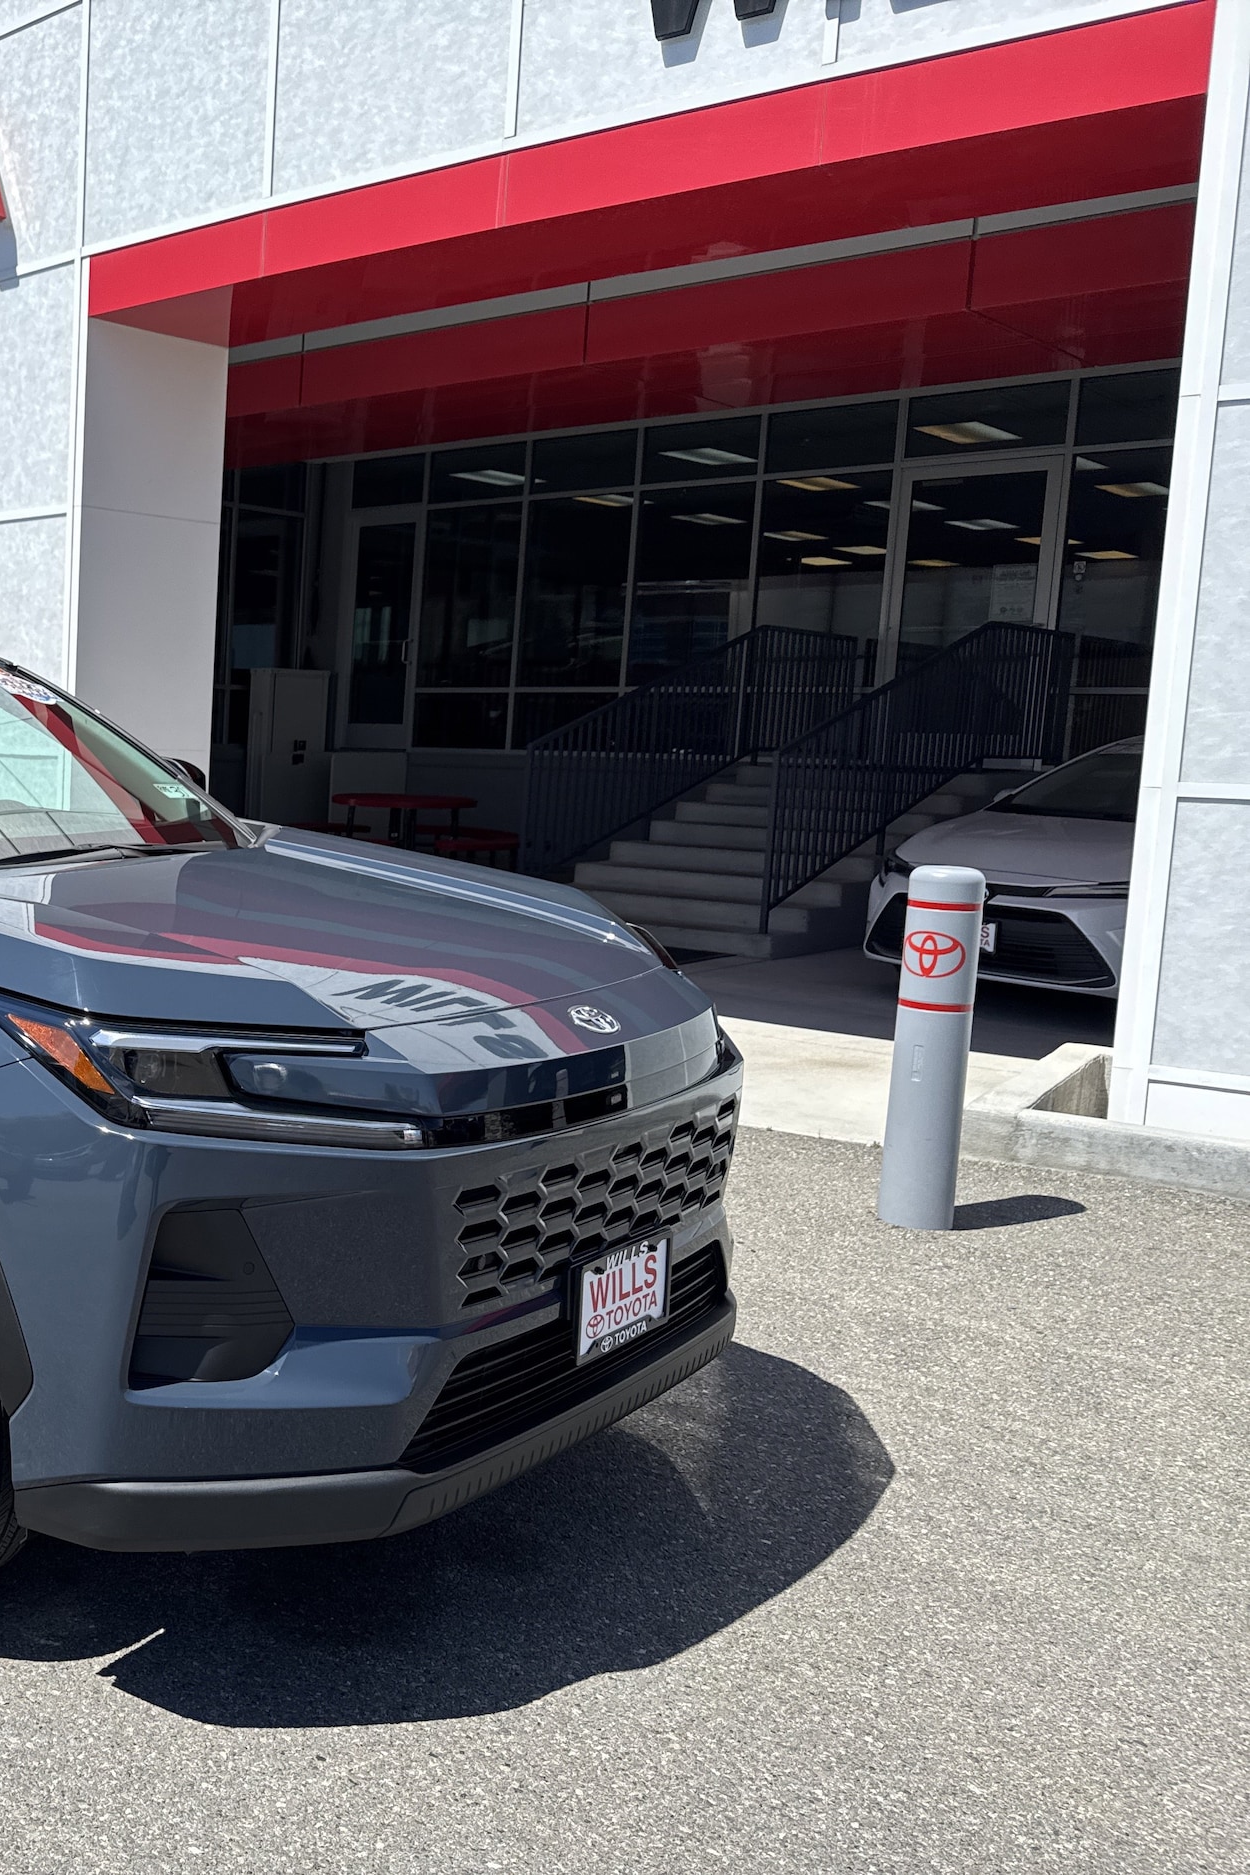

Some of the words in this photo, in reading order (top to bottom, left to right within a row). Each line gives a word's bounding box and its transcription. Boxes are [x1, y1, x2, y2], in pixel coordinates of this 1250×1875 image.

[606, 1241, 649, 1271] WILLS
[590, 1254, 657, 1313] WILLS
[606, 1290, 658, 1329] TOYOTA
[614, 1320, 647, 1345] TOYOTA
